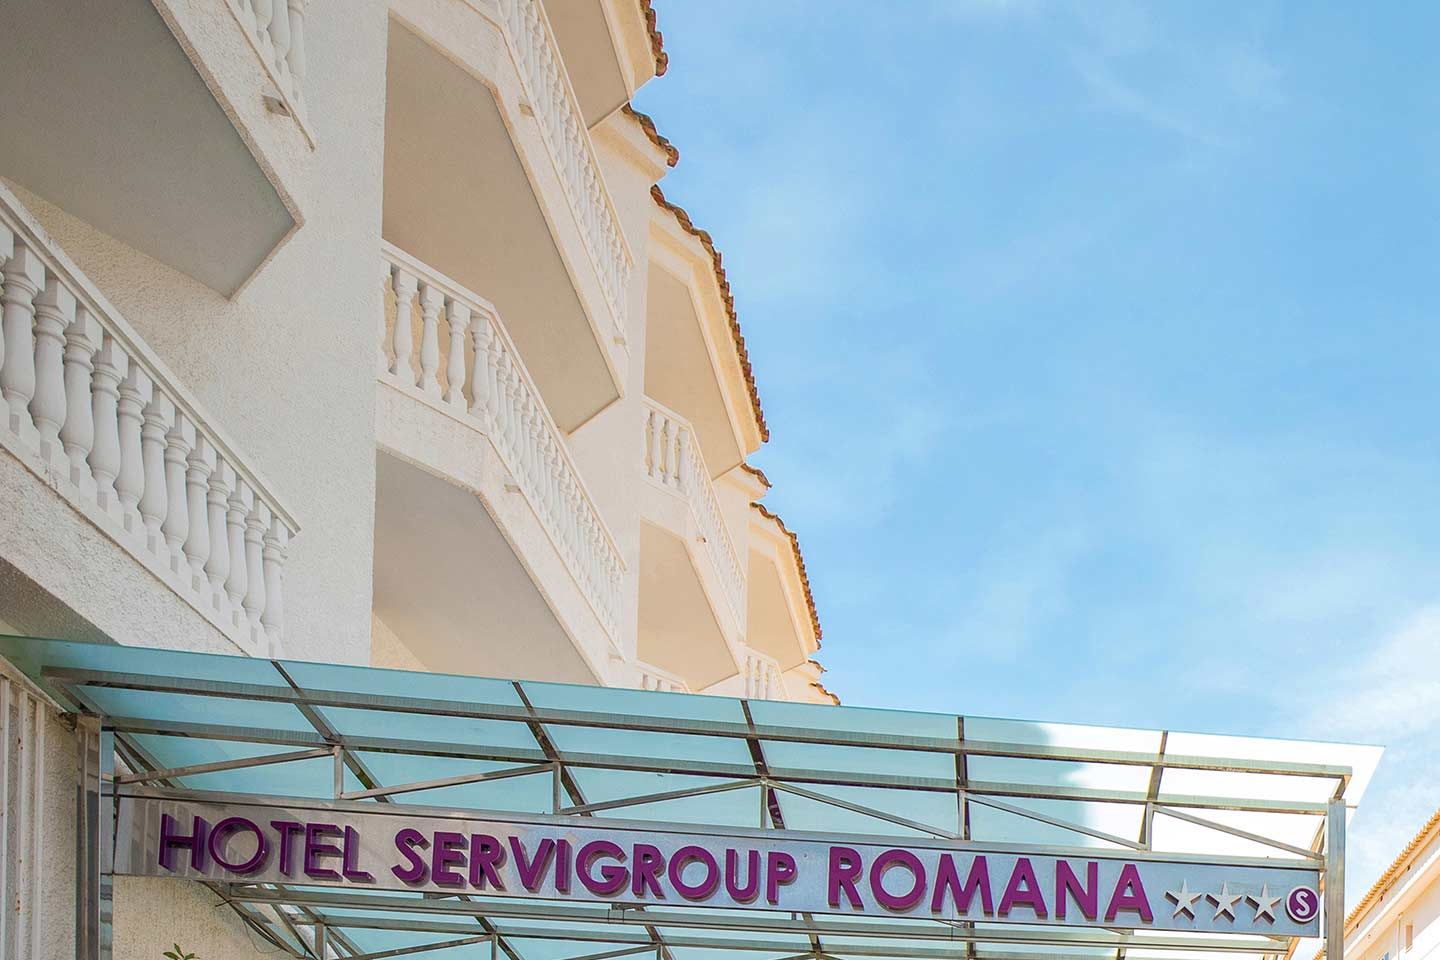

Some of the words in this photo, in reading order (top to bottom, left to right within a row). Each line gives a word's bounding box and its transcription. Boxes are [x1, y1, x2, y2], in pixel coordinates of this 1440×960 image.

[158, 812, 376, 882] HOTEL
[391, 827, 798, 907] SERVIGROUP
[828, 846, 1154, 924] ROMANA
